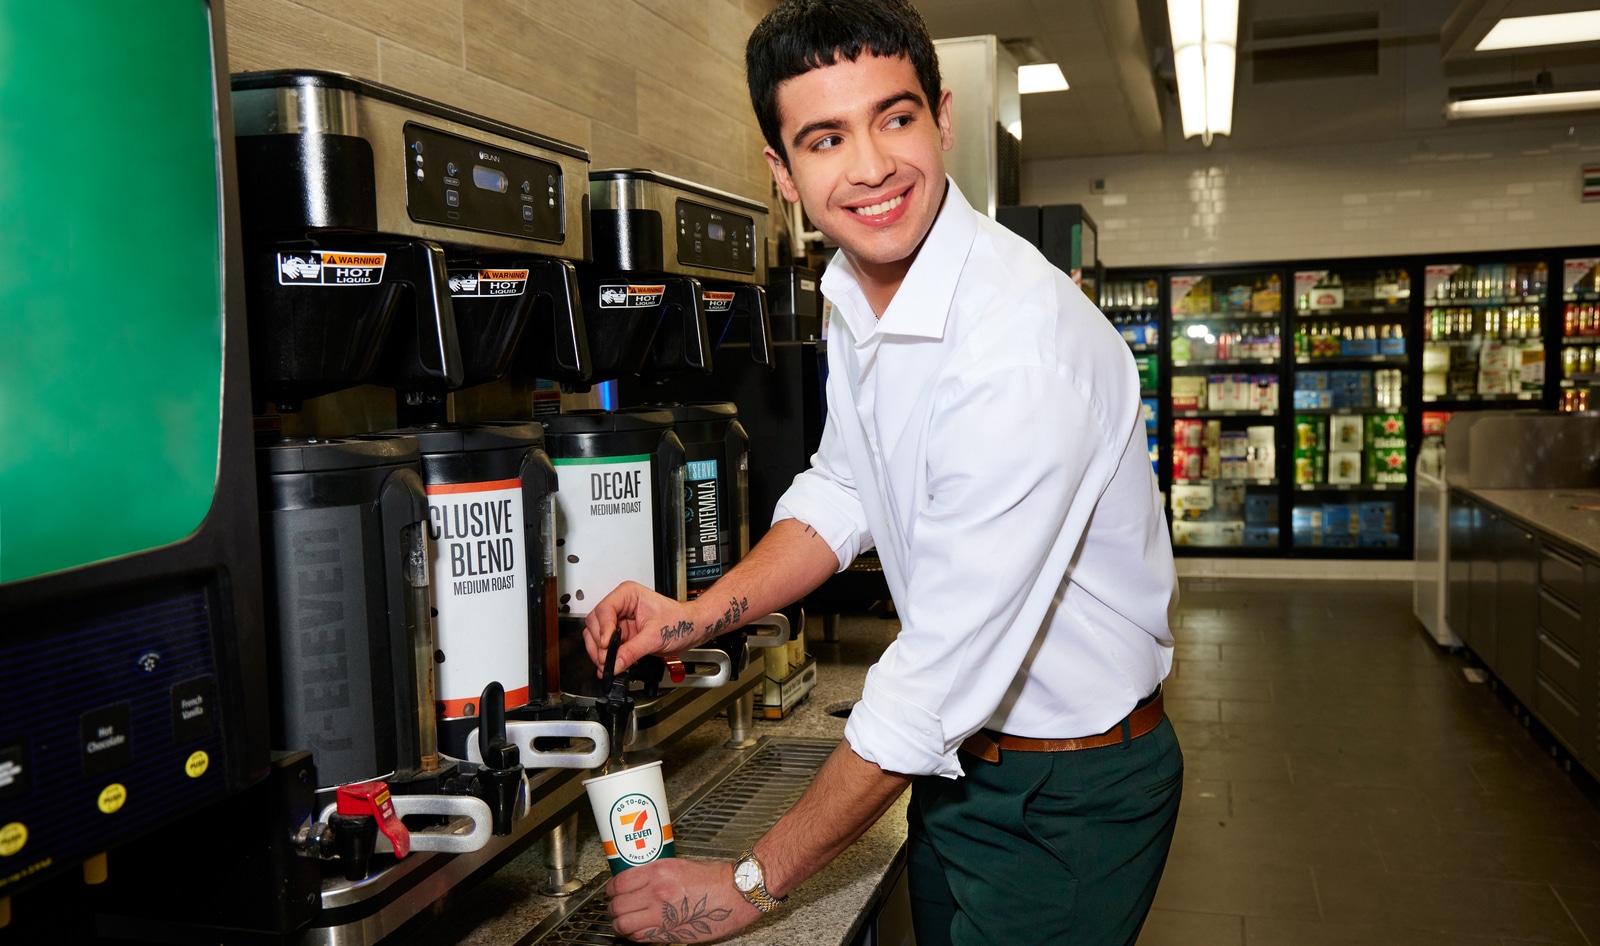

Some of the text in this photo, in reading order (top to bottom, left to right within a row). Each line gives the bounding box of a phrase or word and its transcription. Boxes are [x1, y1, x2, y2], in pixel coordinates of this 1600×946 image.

[483, 153, 500, 163] BUNN
[338, 256, 381, 265] WARNING
[336, 268, 373, 278] HOT
[491, 271, 525, 280] WARNING
[490, 281, 519, 290] HOT
[590, 470, 642, 502] DECAF
[590, 501, 642, 517] MEDIUM ROAST
[697, 480, 718, 543] GUATEMALA
[450, 537, 514, 578] BLEND
[453, 575, 515, 596] MEDIUM ROAST
[181, 694, 204, 710] French
[181, 706, 204, 721] Vanilla
[97, 725, 114, 738] Hot
[86, 734, 126, 754] Chocolate
